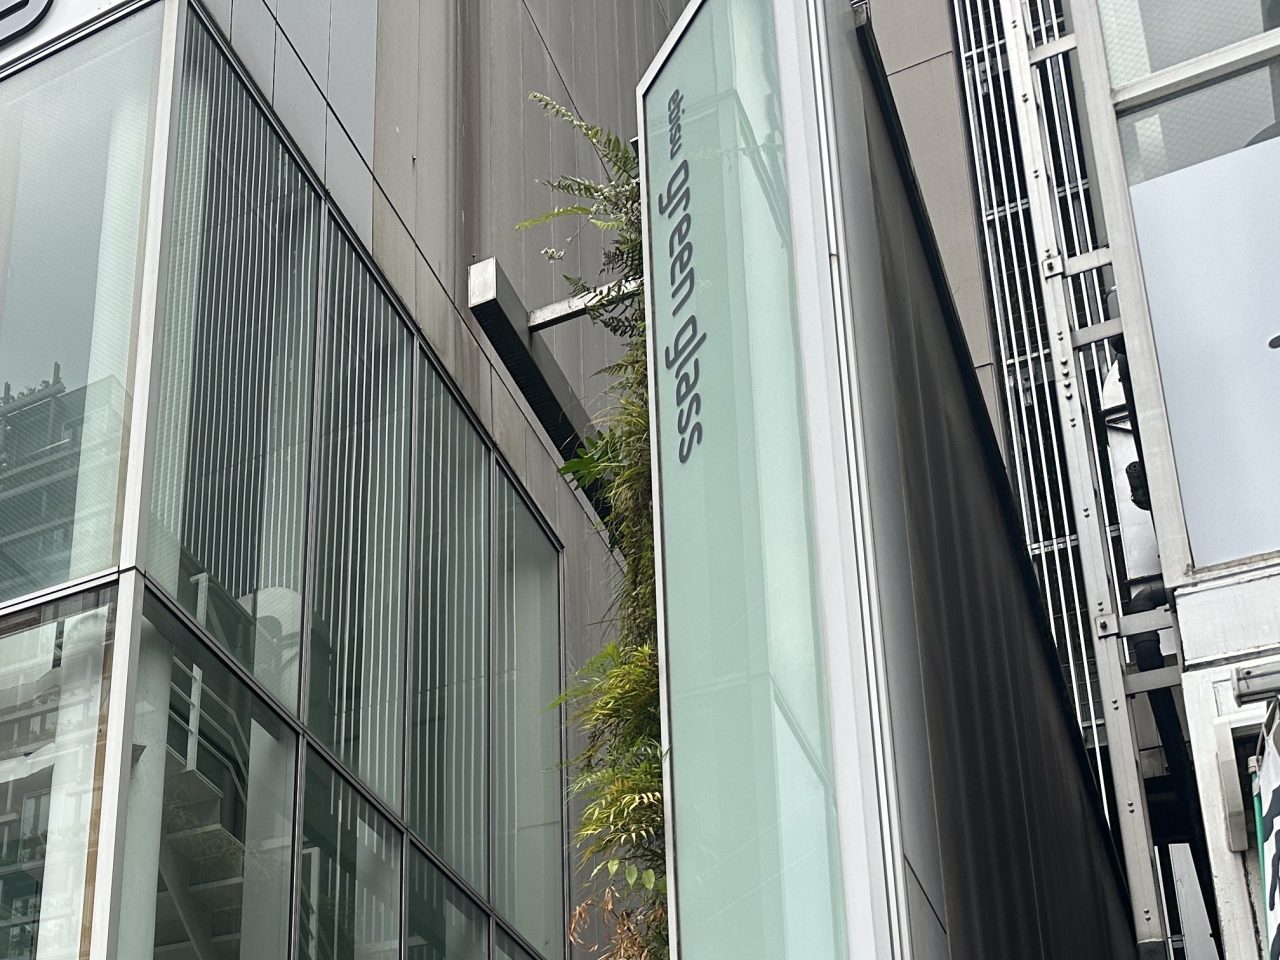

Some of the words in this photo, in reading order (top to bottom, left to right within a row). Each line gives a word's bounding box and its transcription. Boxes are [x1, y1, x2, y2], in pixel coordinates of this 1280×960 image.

[668, 88, 686, 160] ebisu
[659, 158, 695, 318] green
[665, 314, 707, 464] glass
